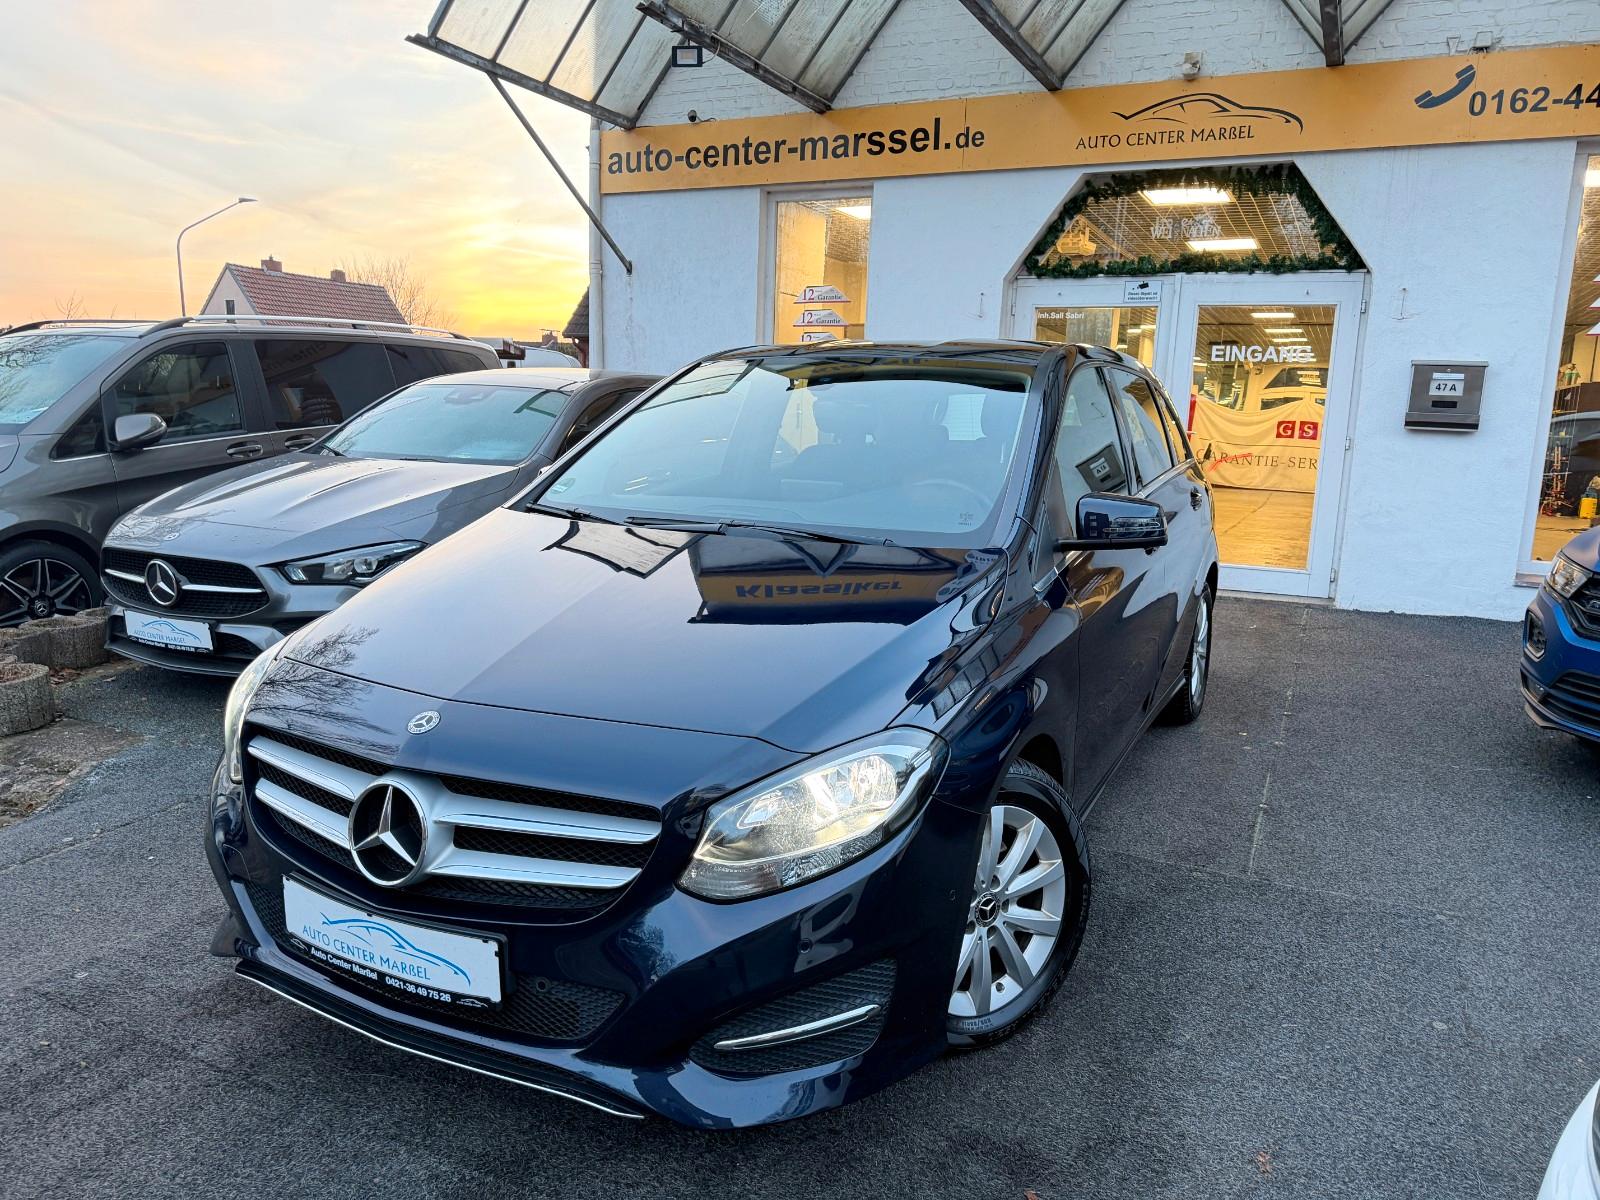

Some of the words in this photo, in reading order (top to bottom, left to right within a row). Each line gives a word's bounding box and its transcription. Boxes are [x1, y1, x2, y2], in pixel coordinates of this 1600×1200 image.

[1468, 83, 1600, 117] 0162-44
[607, 117, 985, 174] auto-center-marssel.de
[1076, 135, 1121, 150] AUTO
[1126, 130, 1185, 146] CENTER
[802, 289, 815, 301] 12
[801, 312, 813, 324] 12
[1211, 345, 1312, 362] EINGANG
[1436, 383, 1447, 392] 47
[1449, 384, 1457, 392] A
[302, 925, 331, 946] AUTO
[333, 939, 376, 964] CENTER
[311, 947, 326, 961] Auto
[327, 954, 352, 970] Center
[385, 976, 415, 994] 0421-36
[416, 986, 427, 997] 49
[428, 989, 439, 1000] 75
[439, 992, 451, 1002] 26
